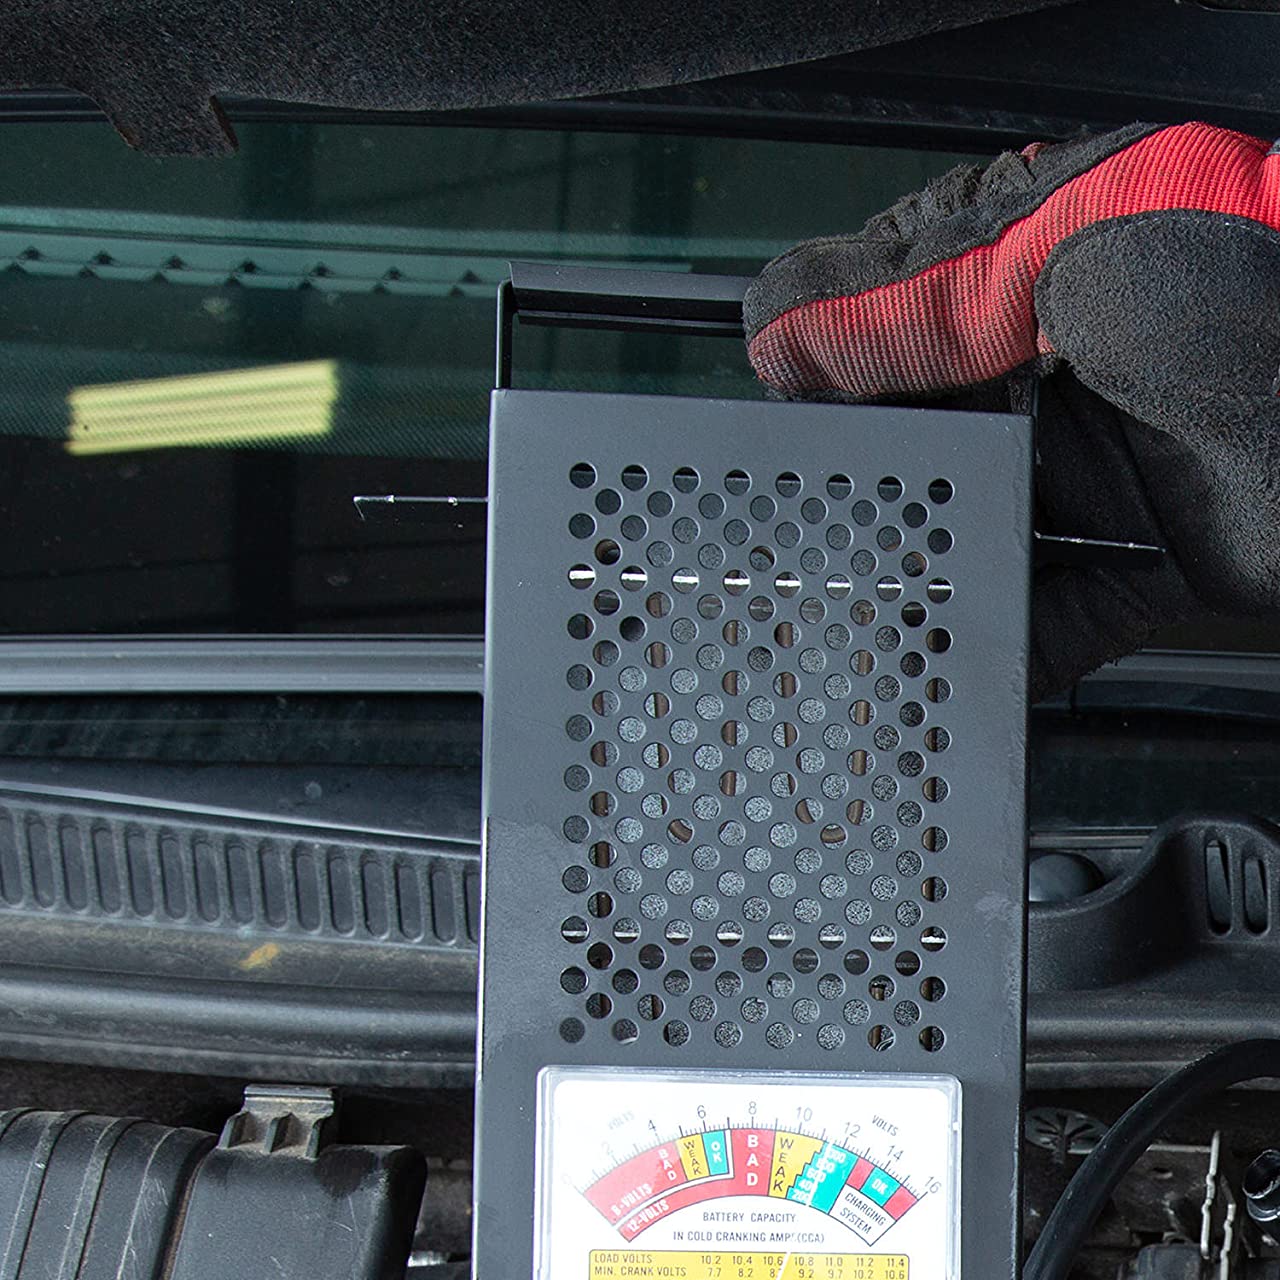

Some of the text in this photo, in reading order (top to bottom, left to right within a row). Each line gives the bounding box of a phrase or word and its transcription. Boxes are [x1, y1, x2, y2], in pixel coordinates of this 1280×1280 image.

[696, 1105, 707, 1119] 6
[748, 1101, 757, 1115] 8
[796, 1106, 813, 1122] 10
[648, 1119, 656, 1131] 4
[844, 1122, 861, 1138] 12
[871, 1114, 898, 1137] VOLTS
[684, 1140, 701, 1175] WEAK
[711, 1141, 722, 1163] OK
[747, 1135, 759, 1186] BAD
[887, 1145, 904, 1162] 14
[657, 1149, 677, 1181] BAD
[773, 1138, 794, 1192] WEAK
[871, 1179, 888, 1195] OK
[924, 1176, 942, 1194] 16
[627, 1199, 670, 1233] 12-VOLTS
[703, 1212, 796, 1223] BATTERY CAPACITY
[844, 1192, 887, 1226] CHARGING
[839, 1207, 872, 1235] SYSTEM
[673, 1231, 684, 1241] IN
[687, 1231, 713, 1241] COLD
[716, 1232, 766, 1242] CRANKING
[595, 1253, 904, 1267] LOAD VOLTS 10.2 10.4 10.6 10.8 11.0 11.2 11.4
[595, 1266, 616, 1276] MIN.
[621, 1266, 654, 1276] CRANK
[658, 1267, 687, 1277] VOLTS
[709, 1268, 721, 1277] 7.7
[738, 1268, 754, 1278] 8.2
[798, 1269, 814, 1279] 9.2
[828, 1269, 843, 1279] 9.7
[854, 1269, 873, 1279] 10.2
[885, 1270, 904, 1280] 10.6
